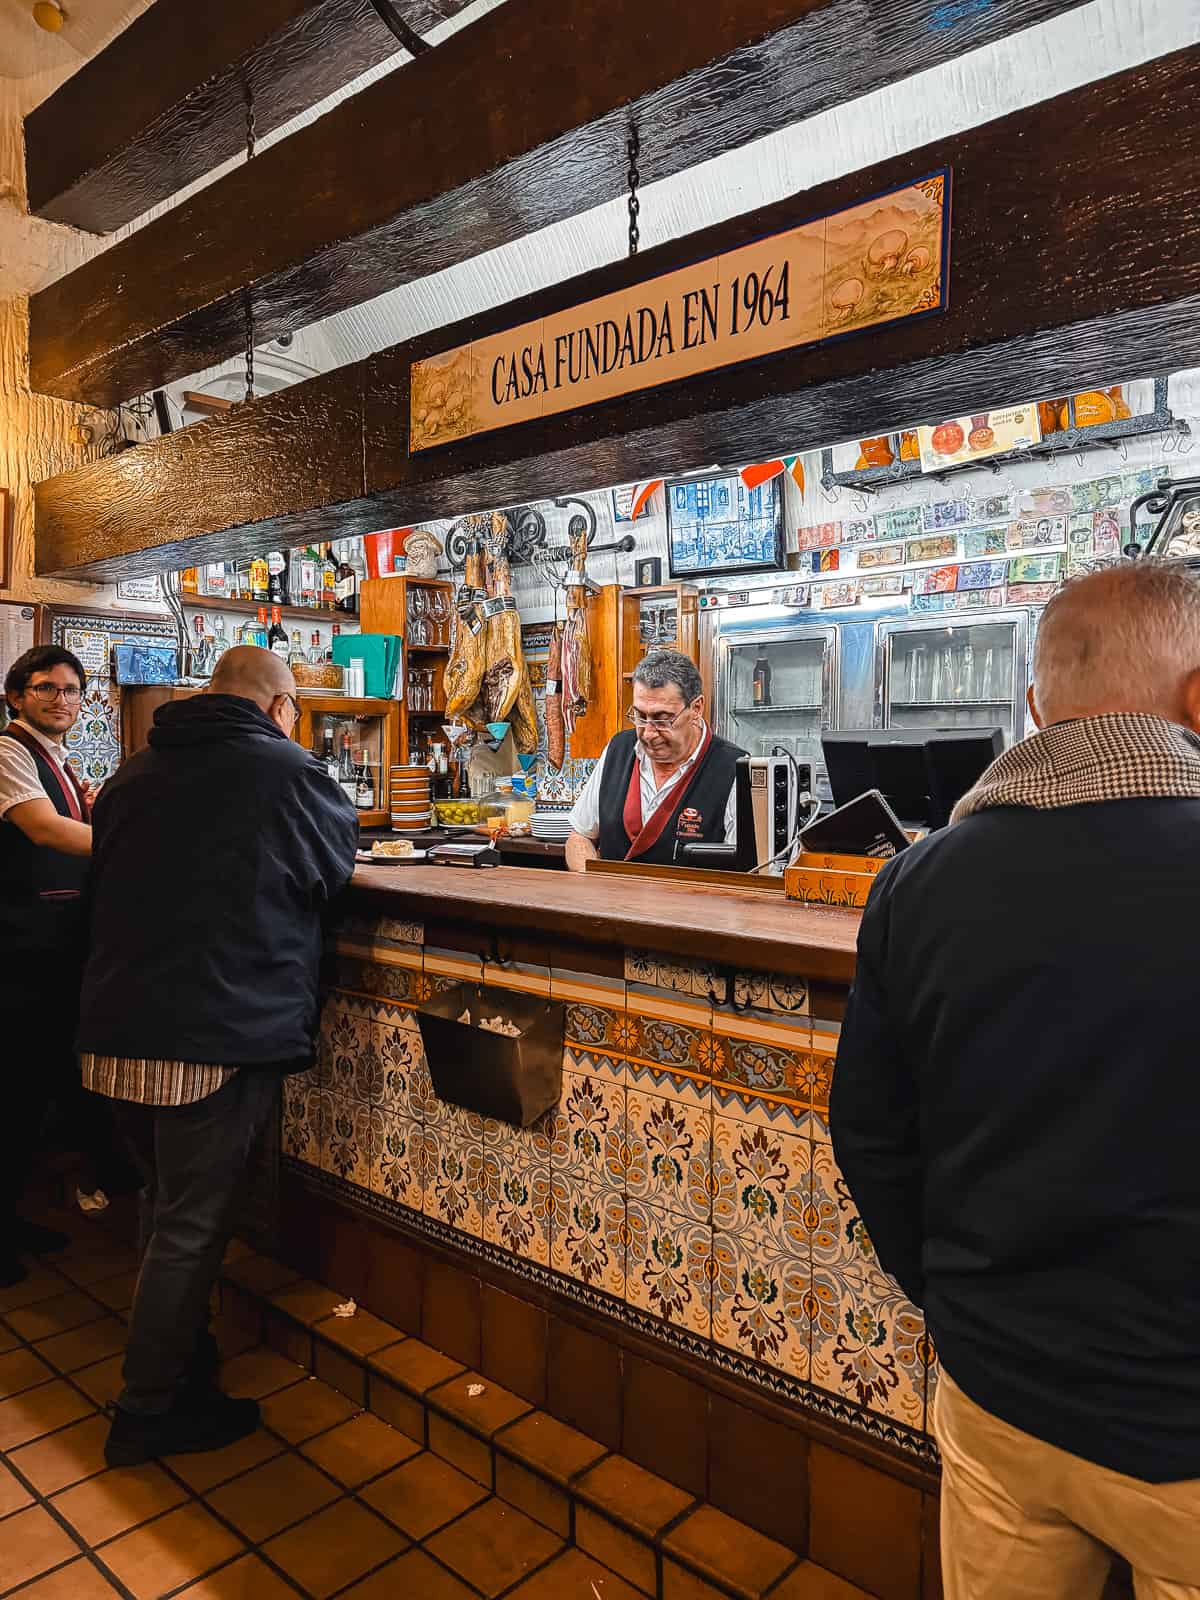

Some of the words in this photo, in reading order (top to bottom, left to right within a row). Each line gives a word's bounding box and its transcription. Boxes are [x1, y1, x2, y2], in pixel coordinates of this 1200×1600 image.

[491, 343, 549, 405] CASA
[553, 301, 675, 389] FUNDADA
[681, 284, 721, 350] EN
[730, 261, 790, 336] 1964
